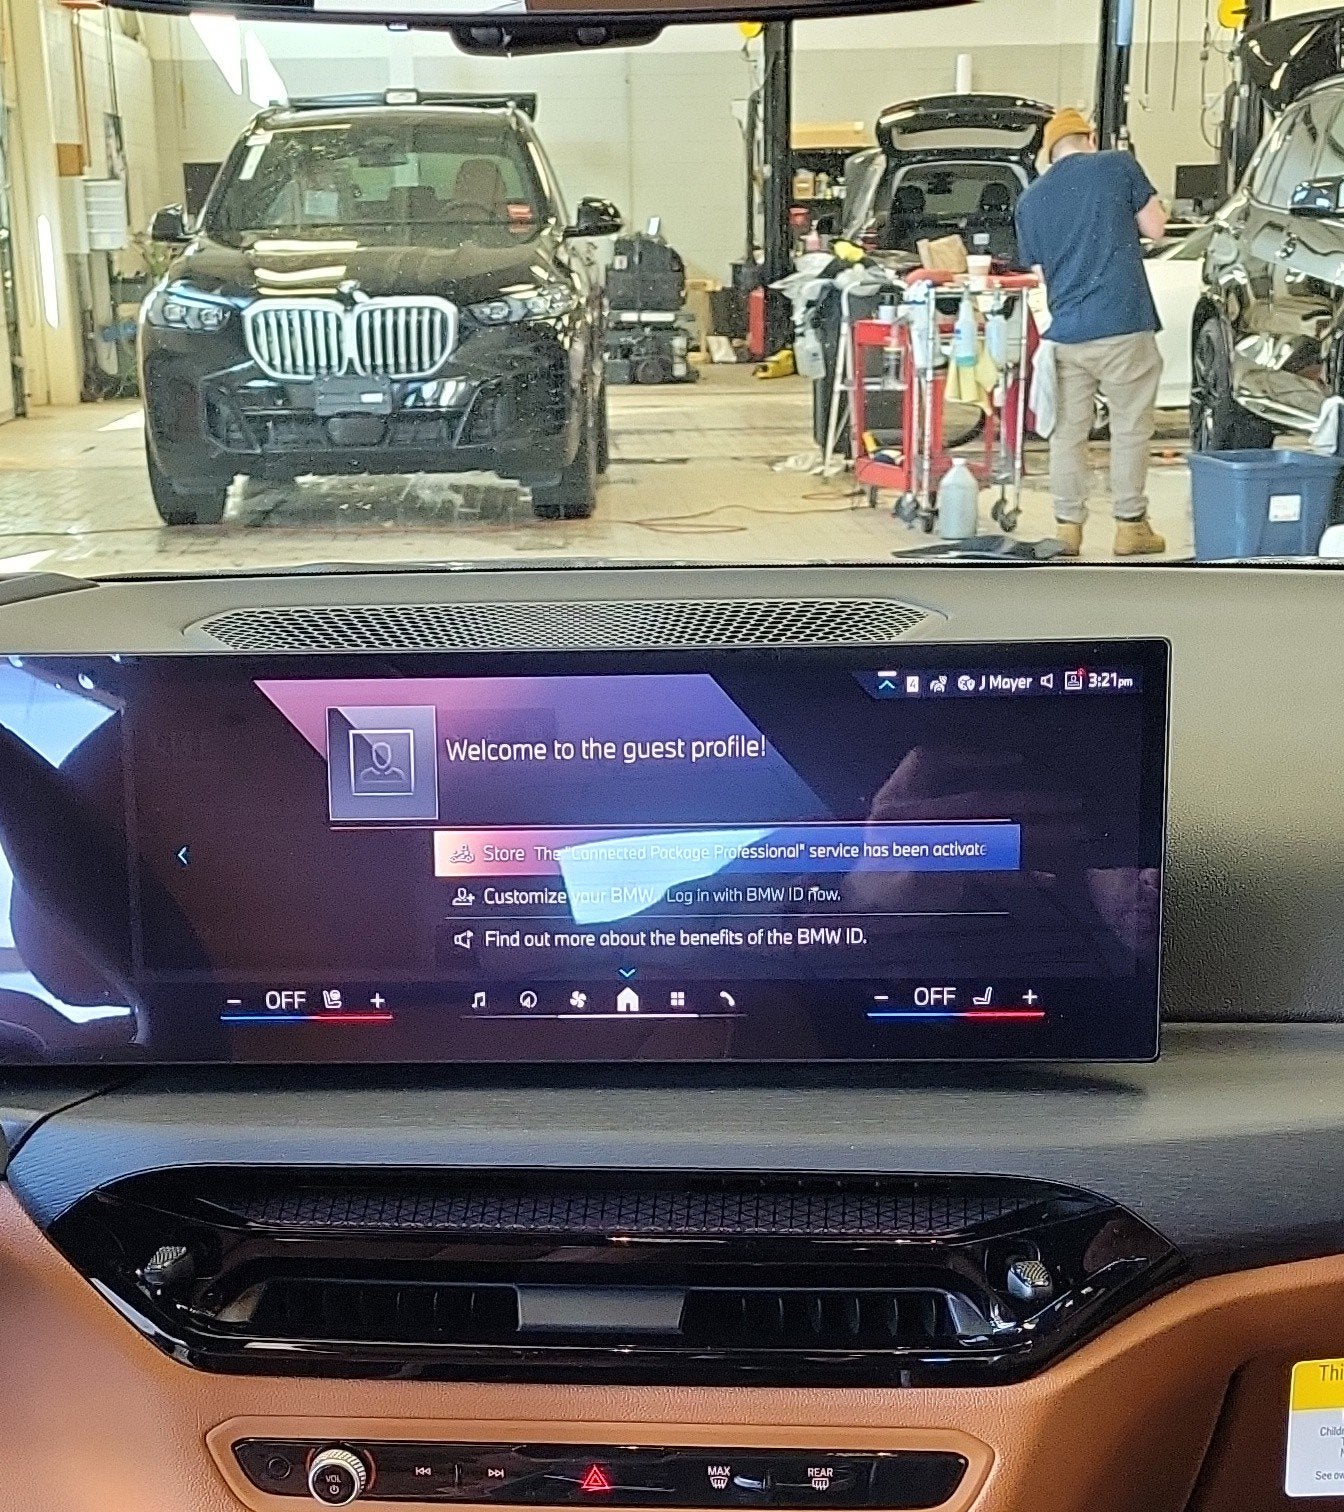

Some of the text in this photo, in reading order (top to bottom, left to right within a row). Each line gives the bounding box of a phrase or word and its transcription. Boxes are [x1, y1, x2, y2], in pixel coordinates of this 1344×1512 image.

[979, 675, 1032, 692] J Mayer
[446, 735, 767, 763] Welcome to the guest profile!
[483, 846, 525, 861] Store
[534, 847, 560, 860] The
[651, 845, 708, 861] Package
[714, 843, 805, 860] Professional"
[809, 844, 859, 857] service
[864, 843, 888, 857] has
[893, 842, 929, 857] been
[483, 888, 566, 905] Customize
[572, 891, 607, 906] your
[667, 889, 692, 905] Log
[697, 888, 709, 902] in
[714, 888, 742, 902] with
[746, 888, 784, 902] BMW
[788, 887, 803, 901] ID
[808, 889, 841, 901] now.
[485, 928, 867, 947] Find out more about the benefits of the BMW ID.
[265, 990, 306, 1009] OFF
[914, 987, 956, 1006] OFF
[325, 1474, 341, 1483] VOL
[707, 1466, 731, 1476] MAX
[808, 1468, 833, 1477] REAR
[1315, 1471, 1332, 1481] See
